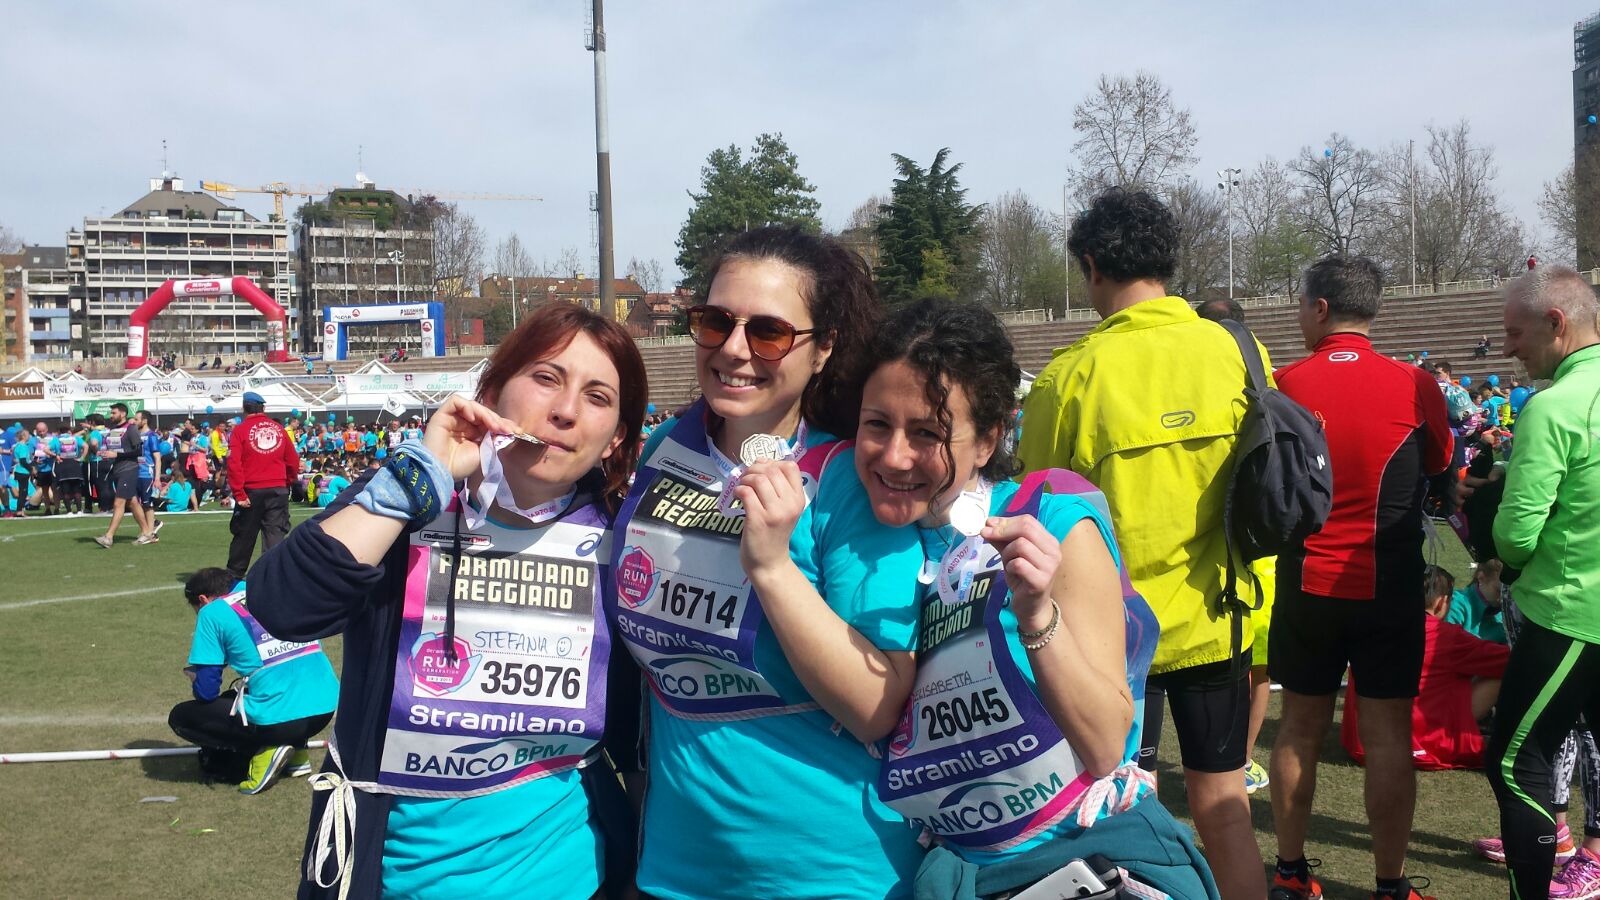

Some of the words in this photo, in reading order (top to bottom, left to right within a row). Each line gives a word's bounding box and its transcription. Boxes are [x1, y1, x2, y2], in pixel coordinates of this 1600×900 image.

[439, 553, 588, 588] PARMIGIANO
[624, 568, 648, 584] RUN
[454, 578, 573, 609] REGGIANO
[660, 579, 738, 629] 16714
[268, 640, 300, 656] BANCO
[472, 630, 549, 654] STEFANIA
[618, 614, 740, 662] Stramilano
[422, 656, 460, 670] RUN
[480, 660, 581, 700] 35976
[704, 673, 760, 696] BPM
[408, 704, 586, 734] Stramilano
[921, 687, 1010, 741] 26045
[405, 752, 508, 776] BANCO
[514, 743, 568, 765] BPM
[888, 734, 1040, 791] Stramilano
[1003, 772, 1064, 816] BPM
